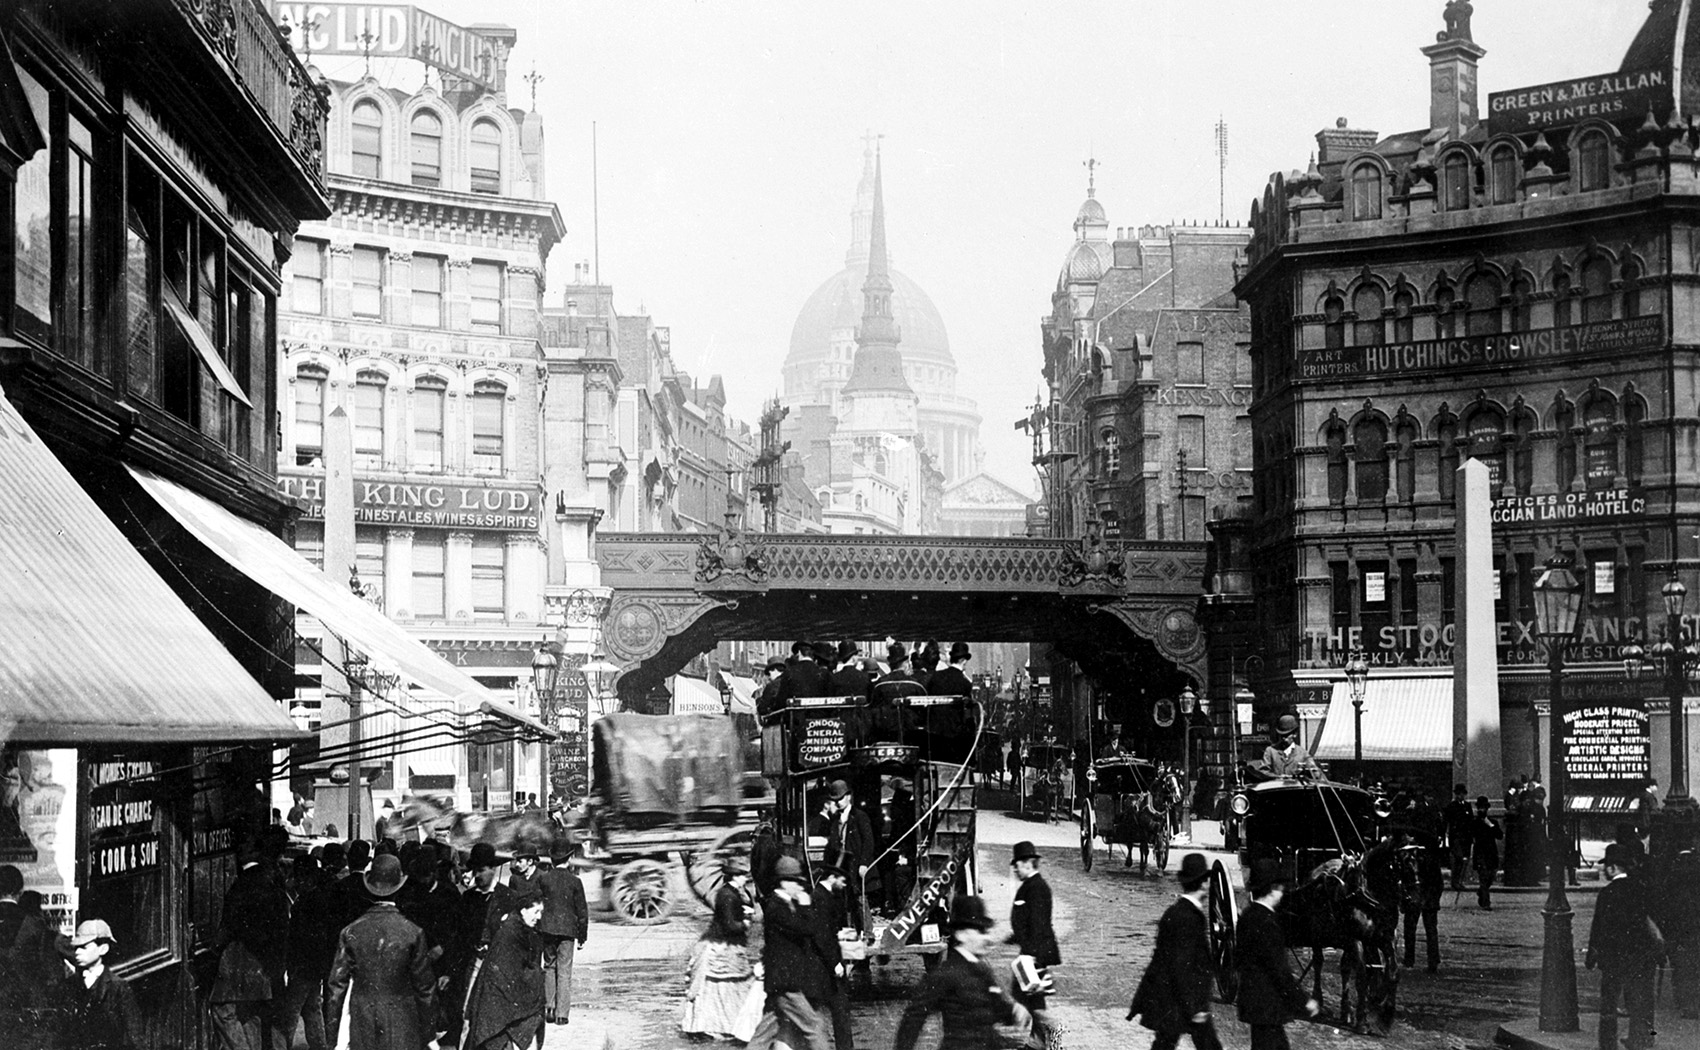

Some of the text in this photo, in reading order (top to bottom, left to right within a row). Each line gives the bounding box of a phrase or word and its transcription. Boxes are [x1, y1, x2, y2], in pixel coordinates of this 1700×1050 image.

[336, 6, 407, 51] LUD
[1492, 90, 1553, 112] GREEN
[1556, 88, 1568, 101] &
[1528, 99, 1628, 125] PRINTERS.
[1315, 350, 1344, 362] ART
[1366, 339, 1471, 372] HUTCHINGS
[277, 477, 533, 511] TH KING LUD.
[1565, 493, 1587, 504] OF
[1595, 489, 1628, 501] THE
[1541, 504, 1576, 520] LAND
[1586, 500, 1630, 517] HOTEL
[485, 514, 537, 529] SPIRITS
[1305, 625, 1364, 650] THE
[1378, 623, 1455, 649] STOC
[1496, 615, 1655, 646] EXANG
[1333, 643, 1653, 666] WEEKLY JOU FOR VESTOS
[556, 676, 586, 687] KING
[1308, 691, 1316, 701] 2
[679, 703, 721, 711] BENSONS
[1563, 706, 1649, 724] HIGH CLASS PRINTING
[1574, 719, 1610, 728] MODERATE
[807, 729, 844, 738] ENERAL
[1578, 736, 1619, 744] COMMERCIAL
[1620, 736, 1651, 744] PRINTING
[800, 745, 846, 754] COMPANY
[1568, 745, 1645, 755] ARTISTIC DESIGNS
[804, 753, 842, 764] LIMITED
[1566, 763, 1649, 772] GENERAL PRINTERS
[112, 804, 123, 827] DE
[124, 800, 153, 824] CHANGE
[101, 845, 127, 875] COOK
[130, 844, 137, 869] &
